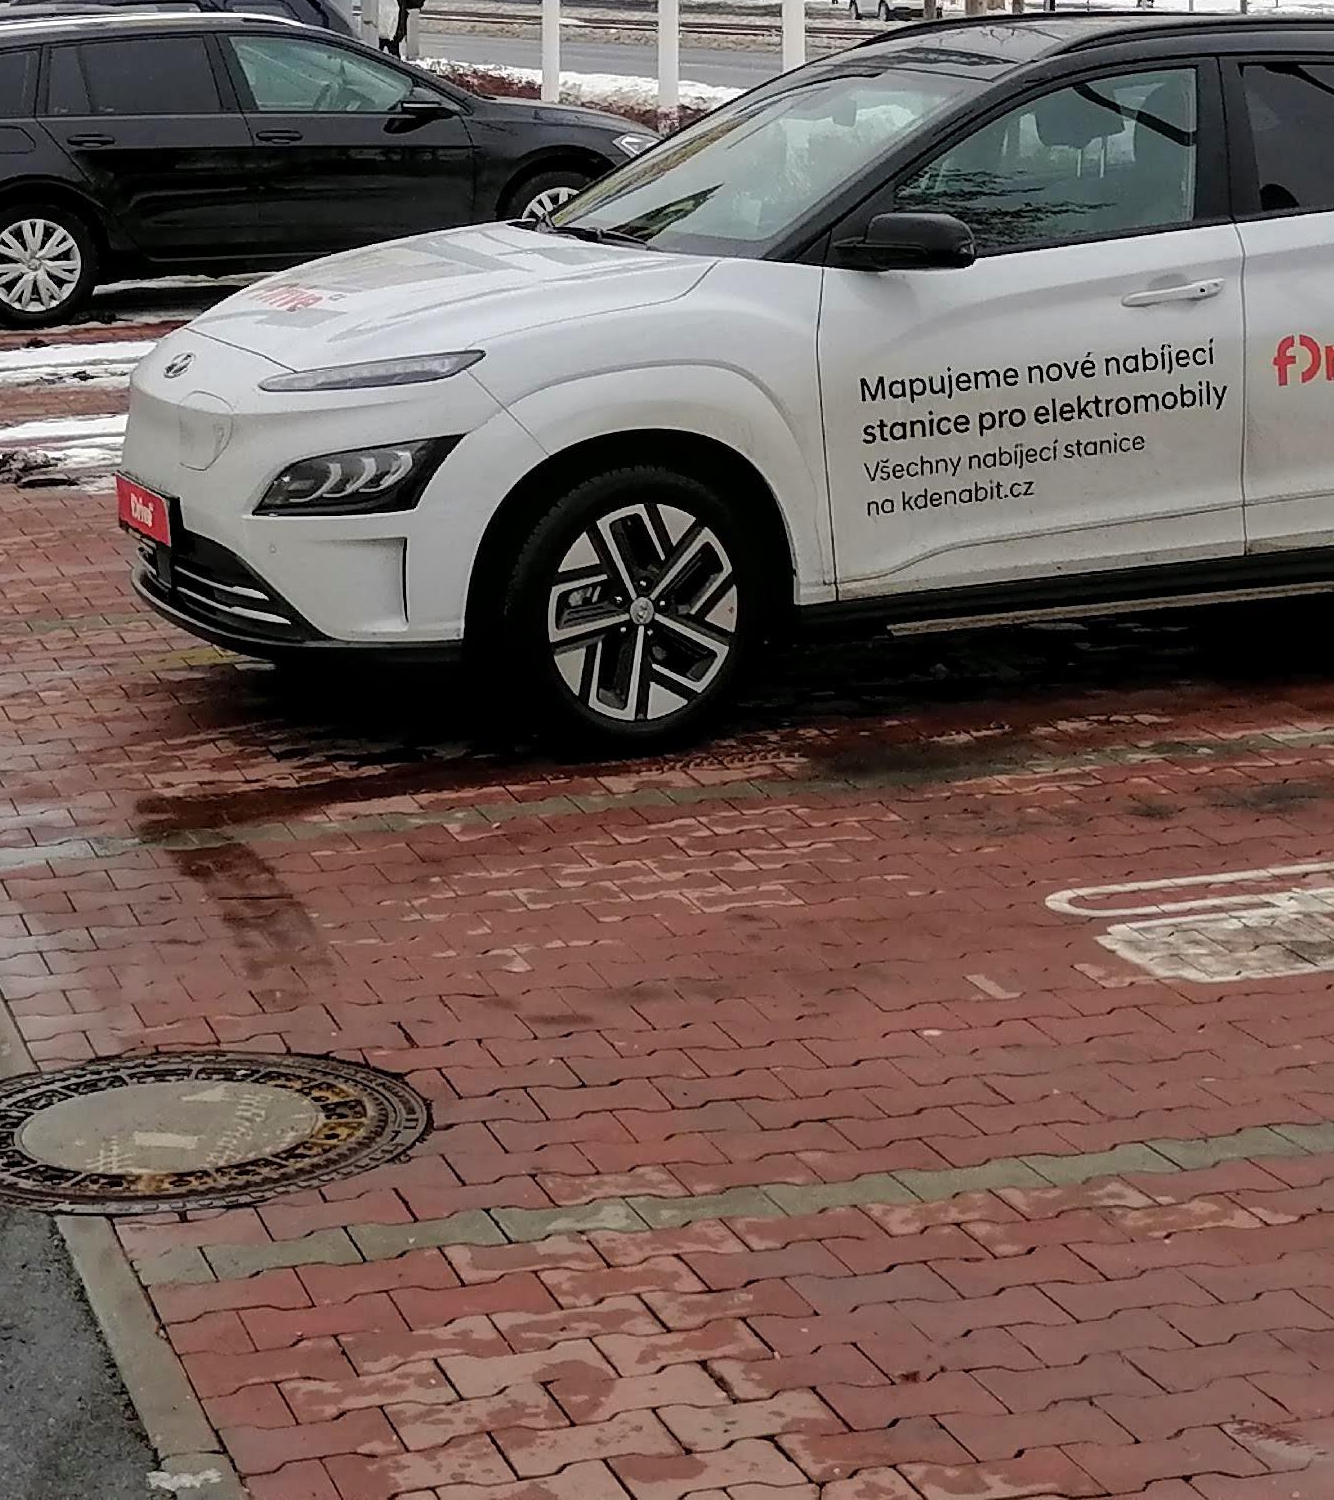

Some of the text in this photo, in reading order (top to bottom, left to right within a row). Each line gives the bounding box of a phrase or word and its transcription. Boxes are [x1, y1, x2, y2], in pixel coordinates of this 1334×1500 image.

[859, 338, 1216, 406] Mapujeme nové nabíjecí
[862, 380, 1228, 445] stanice pro elektromobily
[863, 431, 1146, 483] Všechny nabíjecí stanice
[866, 476, 1036, 518] na kdenabit.cz
